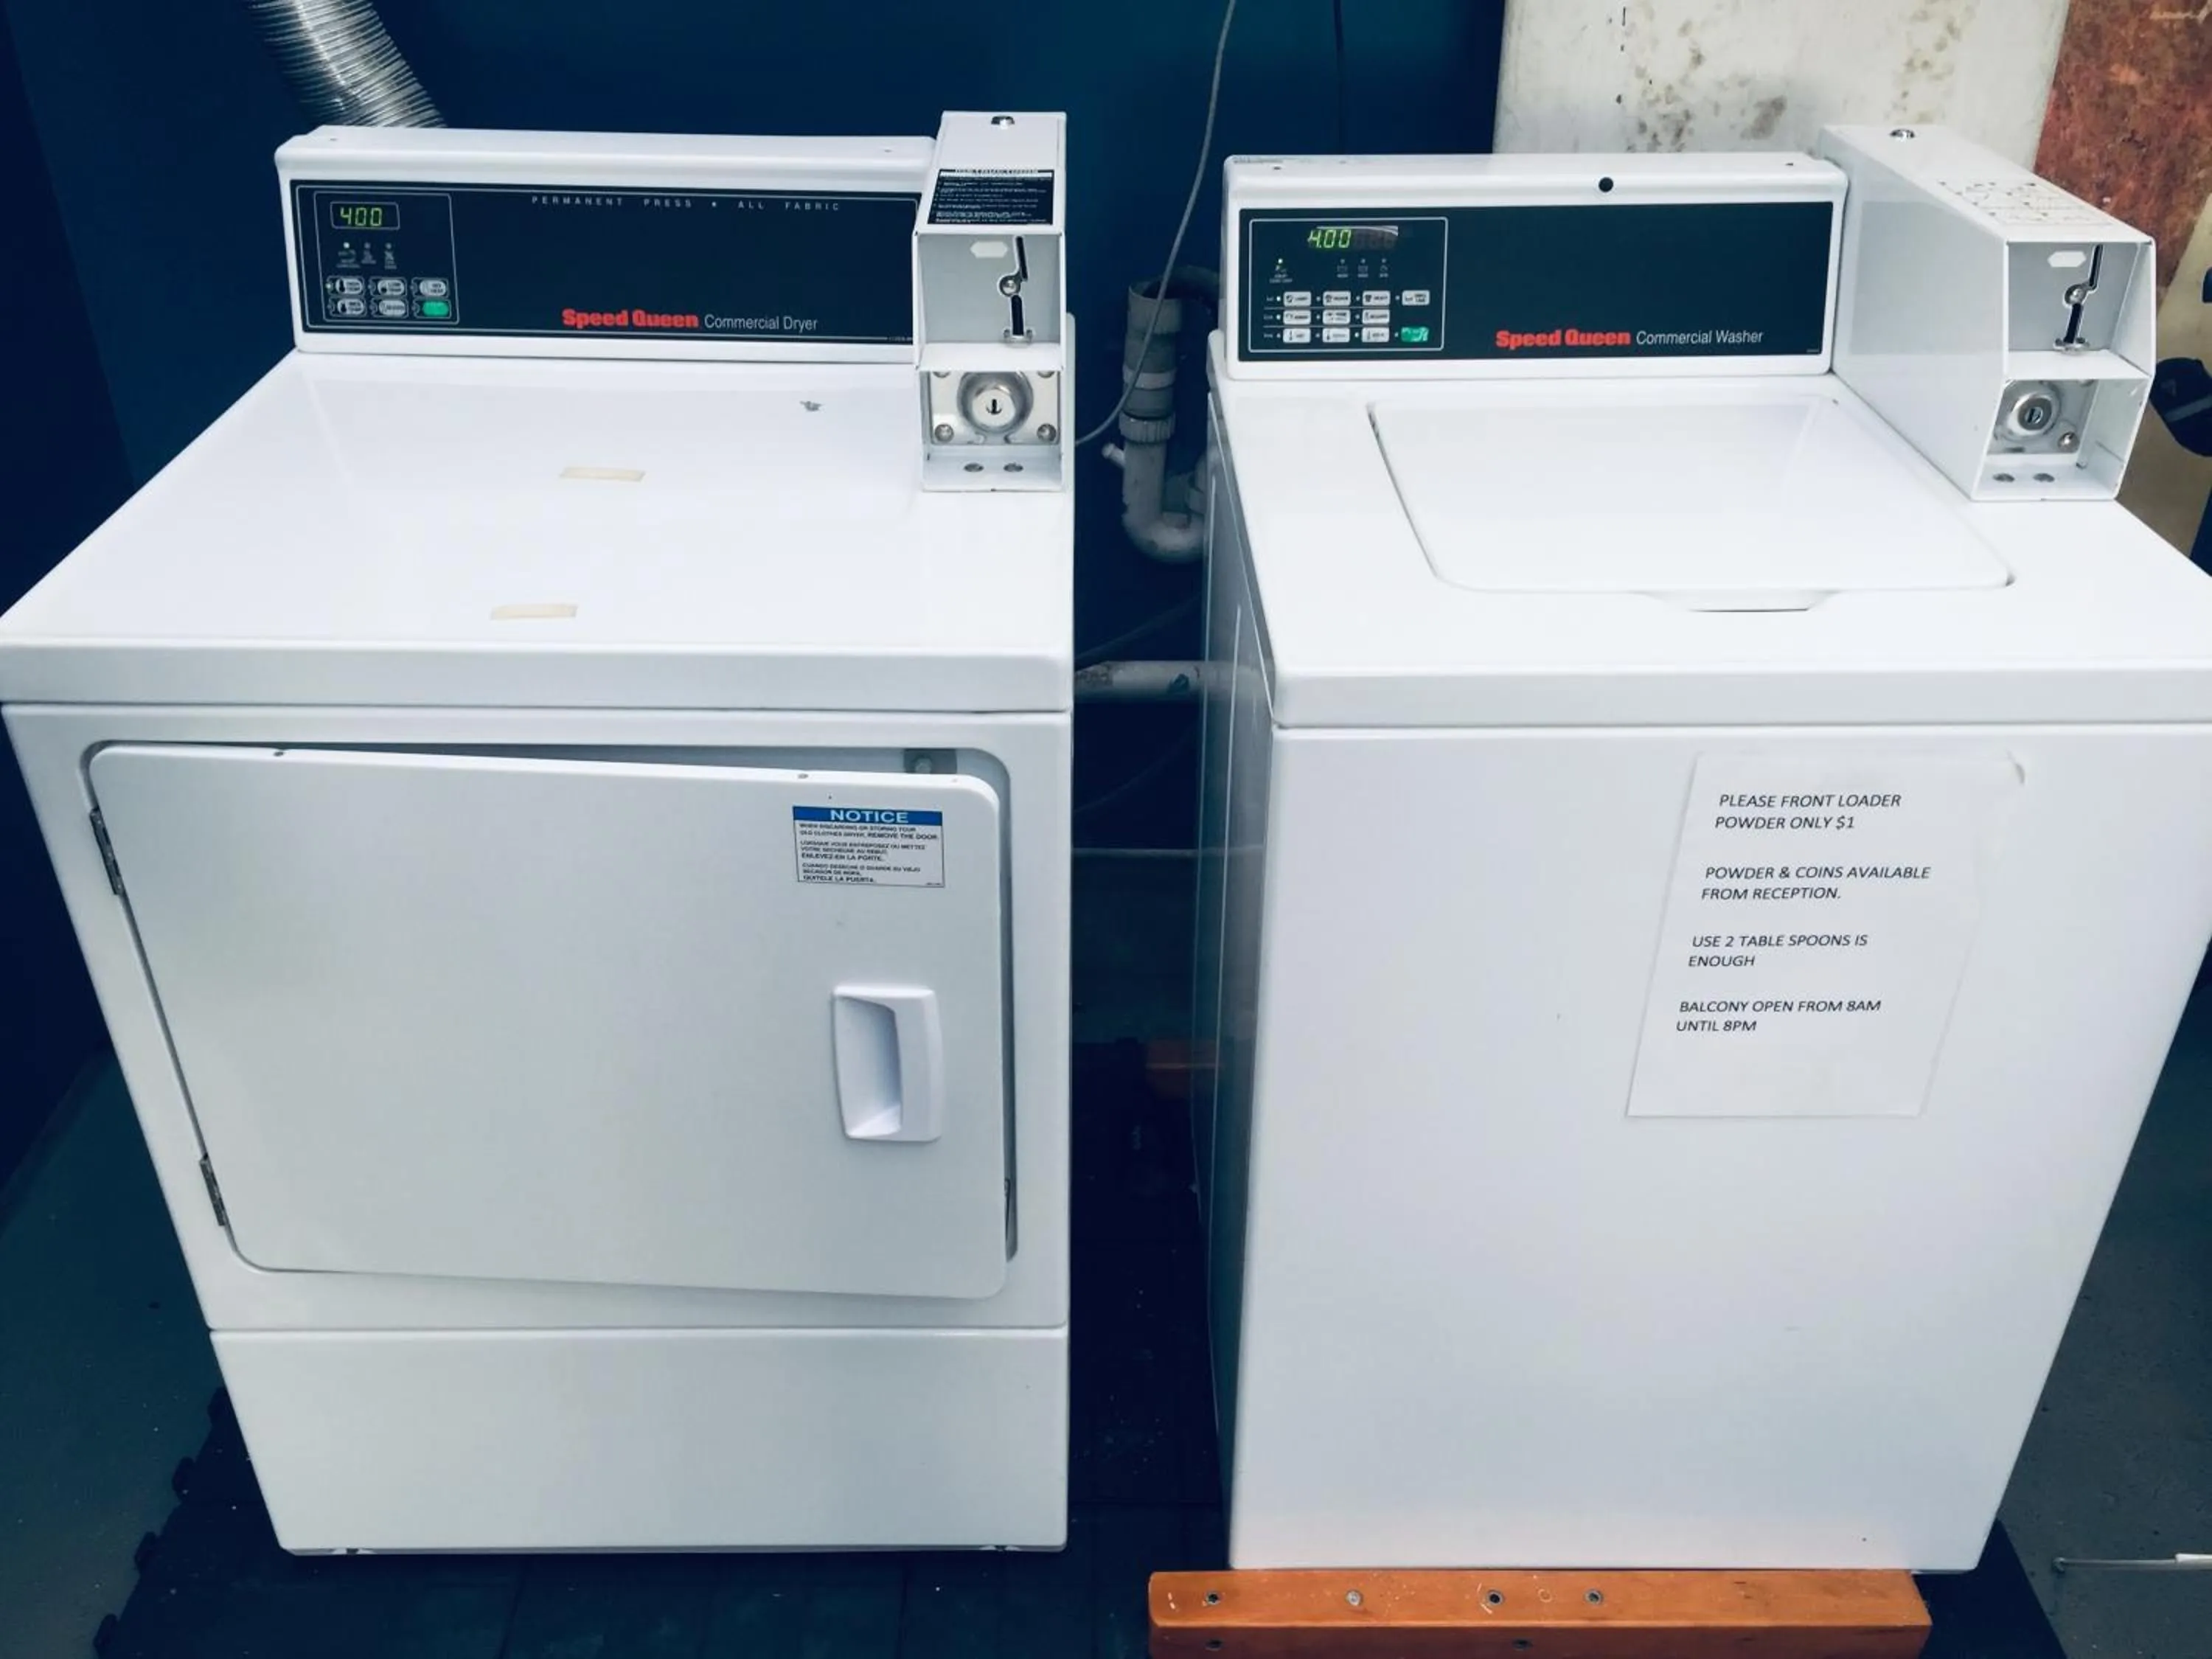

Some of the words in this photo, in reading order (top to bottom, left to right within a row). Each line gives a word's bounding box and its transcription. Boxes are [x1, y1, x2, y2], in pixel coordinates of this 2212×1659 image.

[532, 196, 623, 206] PERMANENT
[644, 198, 692, 207] PRESS
[738, 201, 765, 209] ALL
[785, 201, 839, 211] FABRIC
[563, 308, 628, 329] Speed
[633, 308, 699, 328] Queen
[704, 313, 780, 330] Commercial
[783, 316, 818, 332] Dryer
[1496, 330, 1561, 349] Speed
[1565, 329, 1631, 347] Queen
[1636, 330, 1713, 344] Commercial
[1716, 330, 1763, 344] Washer
[1719, 794, 1777, 808] PLEASE
[1781, 795, 1835, 807] FRONT
[1838, 794, 1902, 807] LOADER
[830, 810, 909, 824] NOTICE
[1715, 816, 1786, 830] POWDER
[1790, 817, 1834, 830] ONLY
[1835, 815, 1854, 830] $1
[1705, 867, 1775, 880] POWDER
[1779, 867, 1791, 880] &
[1795, 866, 1843, 880] COINS
[1846, 866, 1931, 880] AVAILABLE
[1702, 888, 1748, 900] FROM
[1753, 887, 1841, 900] RECEPTION.
[1692, 936, 1722, 947] USE
[1725, 936, 1735, 948] 2
[1739, 936, 1785, 947] TABLE
[1788, 935, 1851, 947] SPOONS
[1854, 935, 1868, 947] IS
[1688, 956, 1756, 967] ENOUGH
[1680, 1001, 1750, 1013] BALCONY
[1752, 1001, 1794, 1012] OPEN
[1798, 1001, 1843, 1012] FROM
[1846, 1001, 1882, 1012] 8AM
[1676, 1020, 1719, 1032] UNTIL
[1723, 1020, 1757, 1032] 8PM
